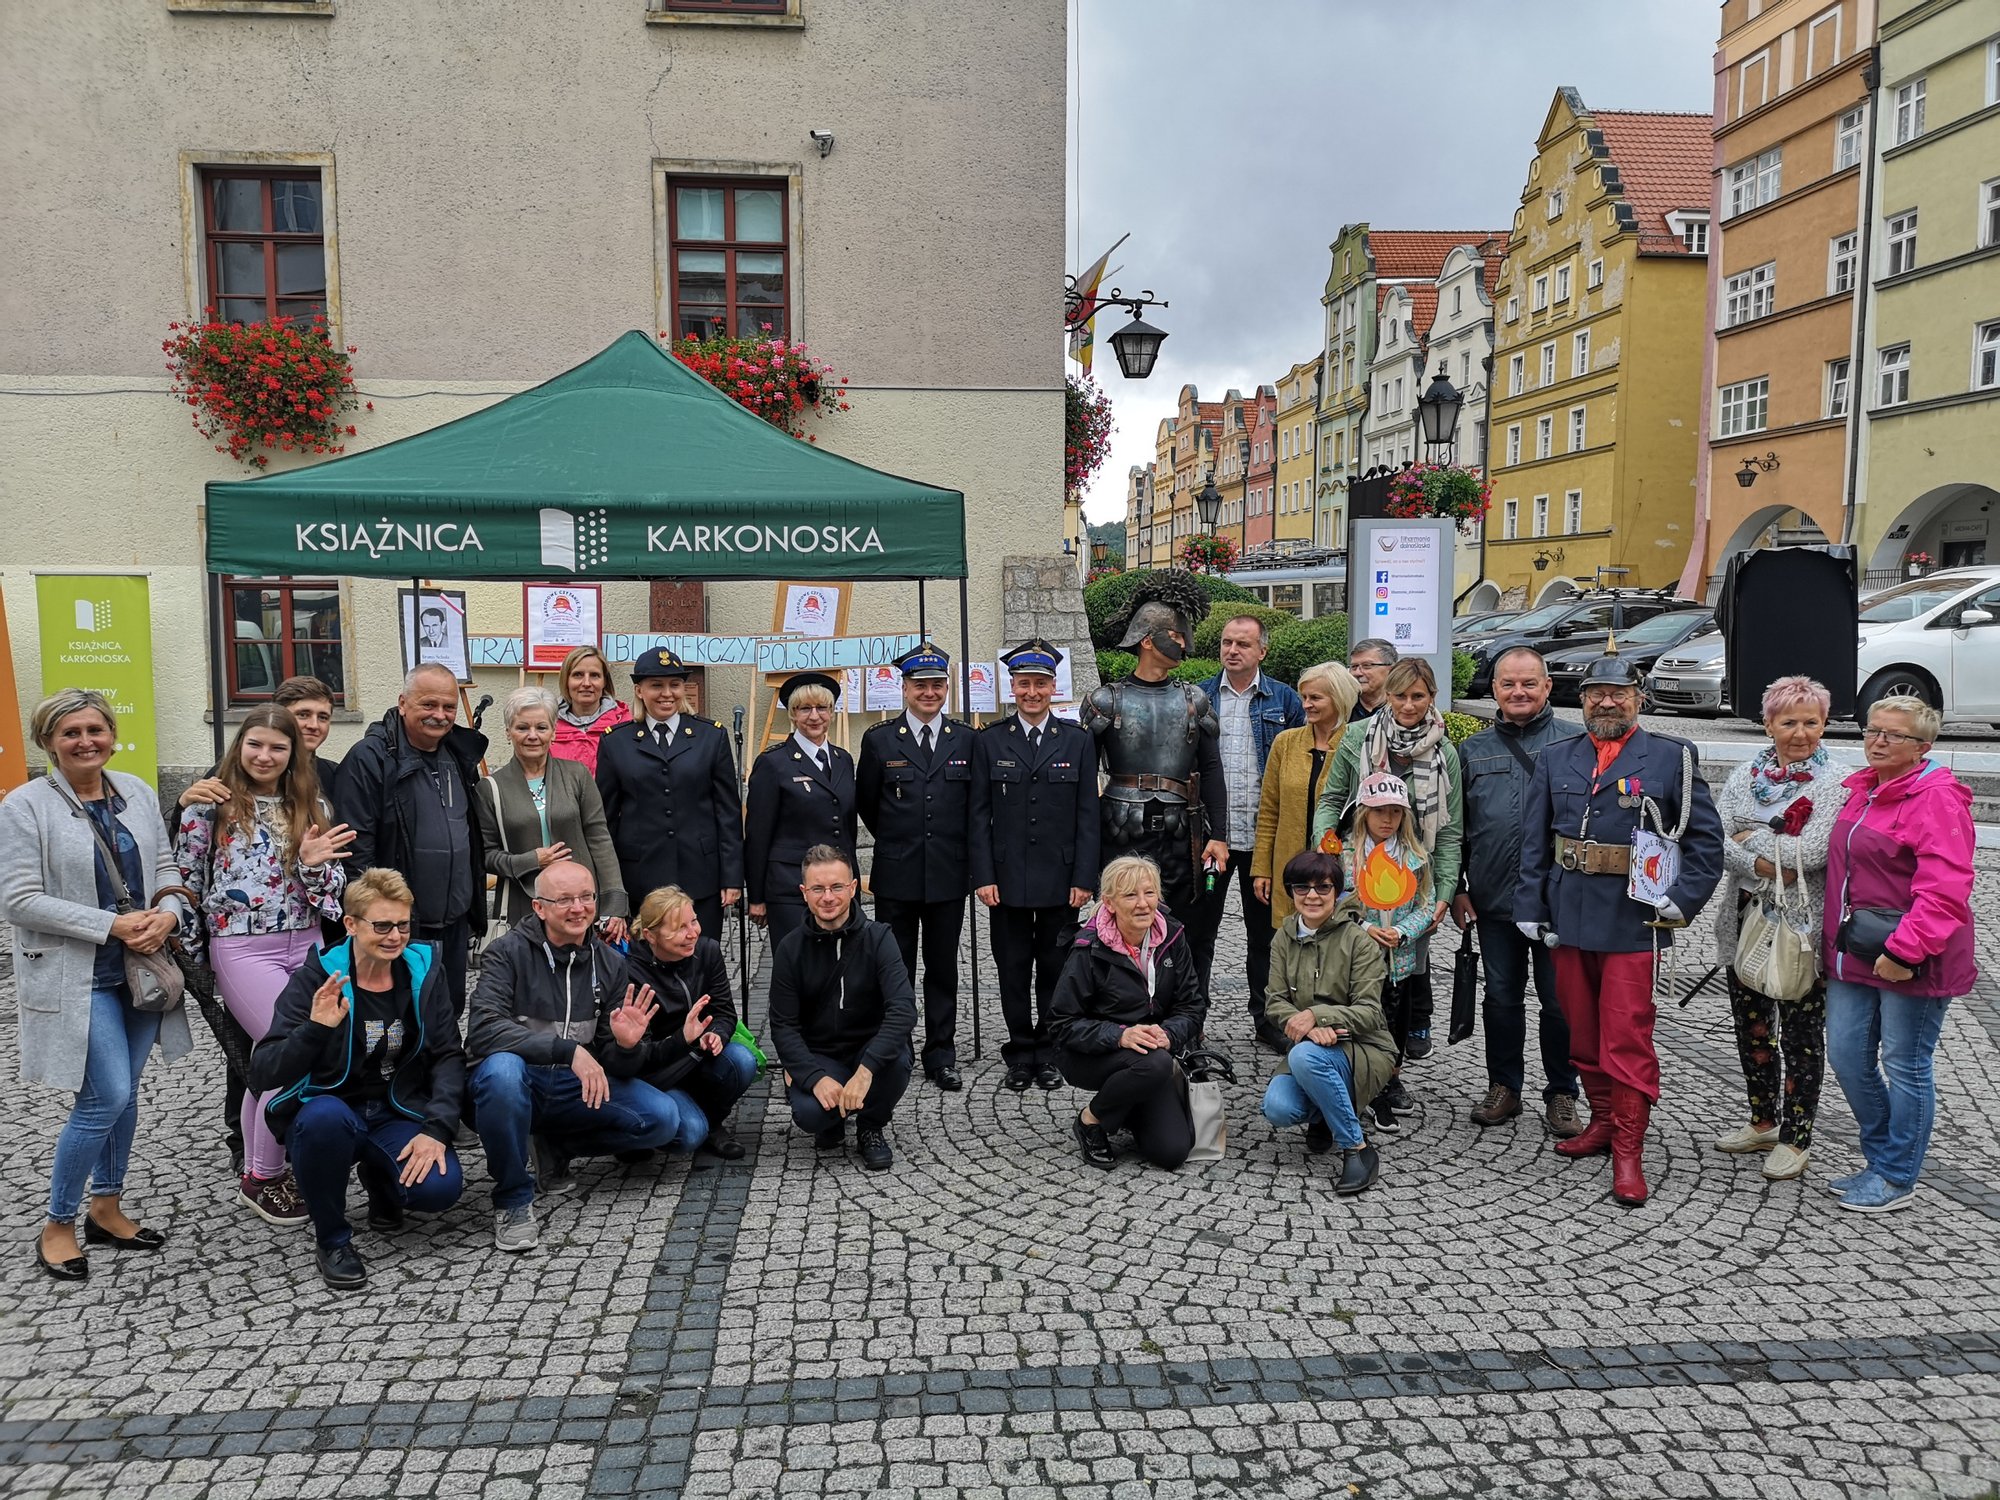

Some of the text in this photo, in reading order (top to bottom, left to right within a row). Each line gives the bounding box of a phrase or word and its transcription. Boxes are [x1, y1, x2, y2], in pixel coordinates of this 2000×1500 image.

[296, 516, 885, 559] KSIĄŻNICA KARKONOSKA
[68, 640, 122, 652] KSIĄŻNICA
[60, 654, 131, 663] KARKONOSKA
[759, 639, 843, 671] POLSKIE
[1368, 782, 1404, 797] LOVE
